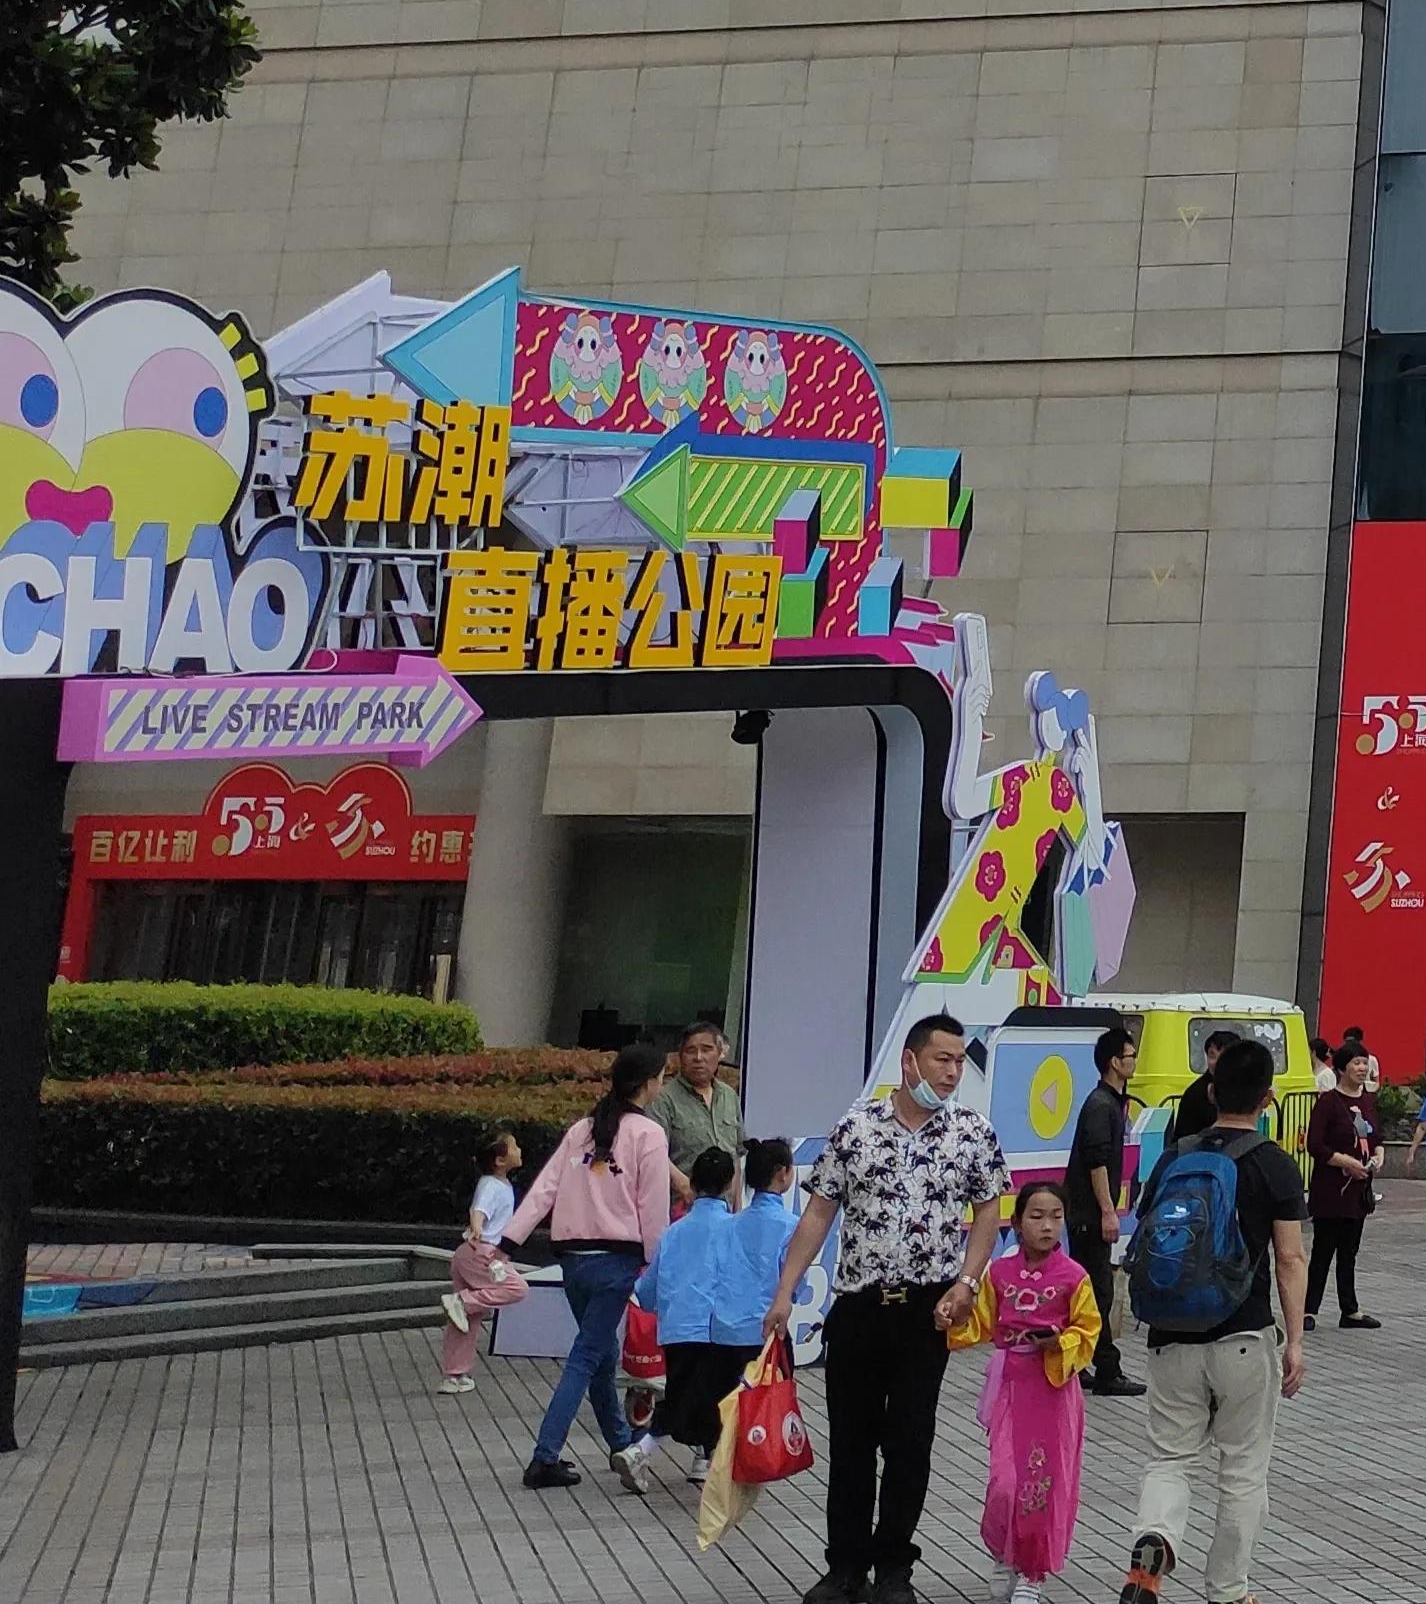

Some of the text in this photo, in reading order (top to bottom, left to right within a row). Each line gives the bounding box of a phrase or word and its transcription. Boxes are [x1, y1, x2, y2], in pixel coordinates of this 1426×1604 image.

[295, 390, 512, 527] 苏潮
[0, 553, 310, 675] CHAO
[438, 547, 784, 671] 直播公园
[142, 701, 427, 735] LIVE STREAM PARK
[88, 830, 198, 863] 百亿让利
[409, 829, 474, 863] 约惠
